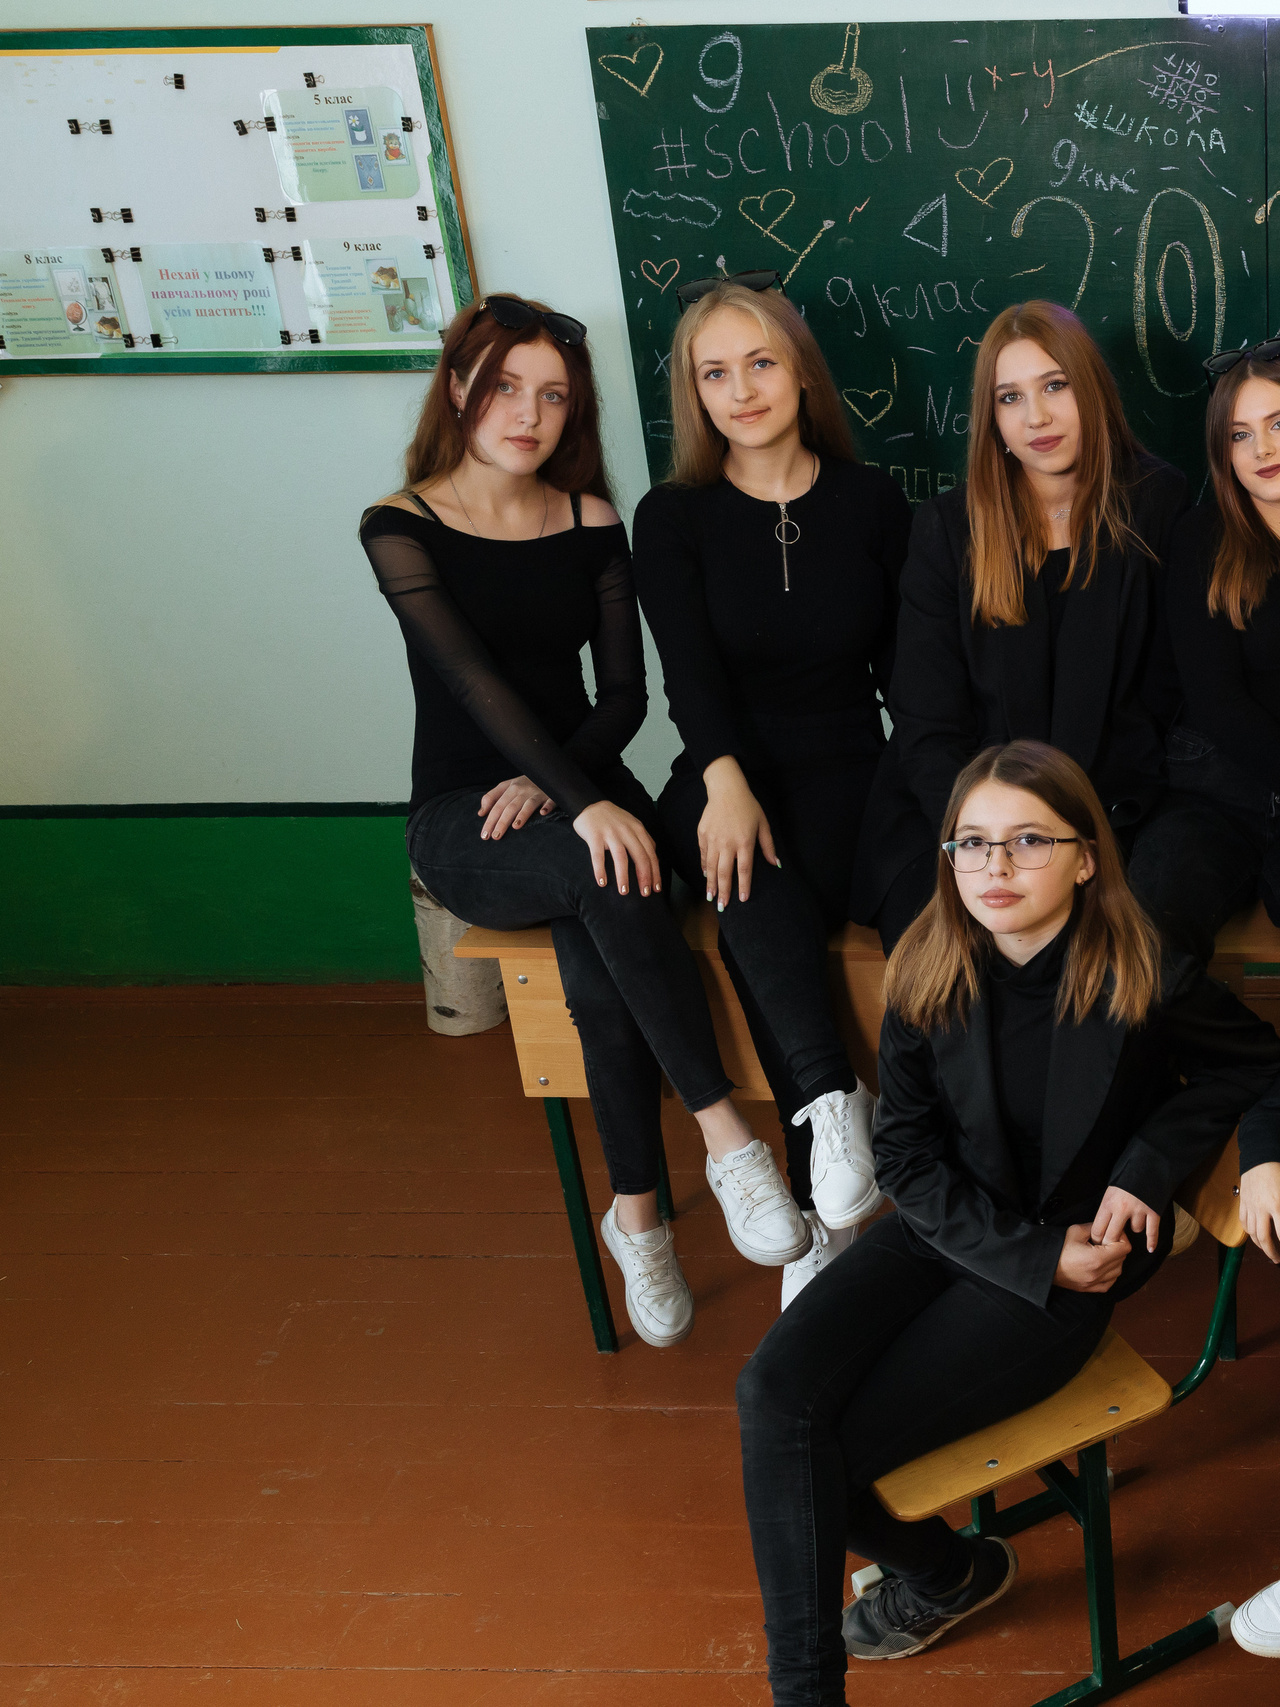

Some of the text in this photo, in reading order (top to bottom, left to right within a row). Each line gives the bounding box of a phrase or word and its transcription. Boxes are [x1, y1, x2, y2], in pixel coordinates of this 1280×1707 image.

[692, 31, 743, 114] 9
[313, 93, 354, 106] 5 клас
[1050, 138, 1079, 188] 9
[343, 241, 382, 253] 9 клас
[24, 253, 63, 265] 8 клас
[158, 268, 255, 283] Нехай у цьому
[151, 286, 272, 301] навчальному році
[163, 304, 266, 321] усім щастить!!!
[826, 276, 990, 338] 9 клас
